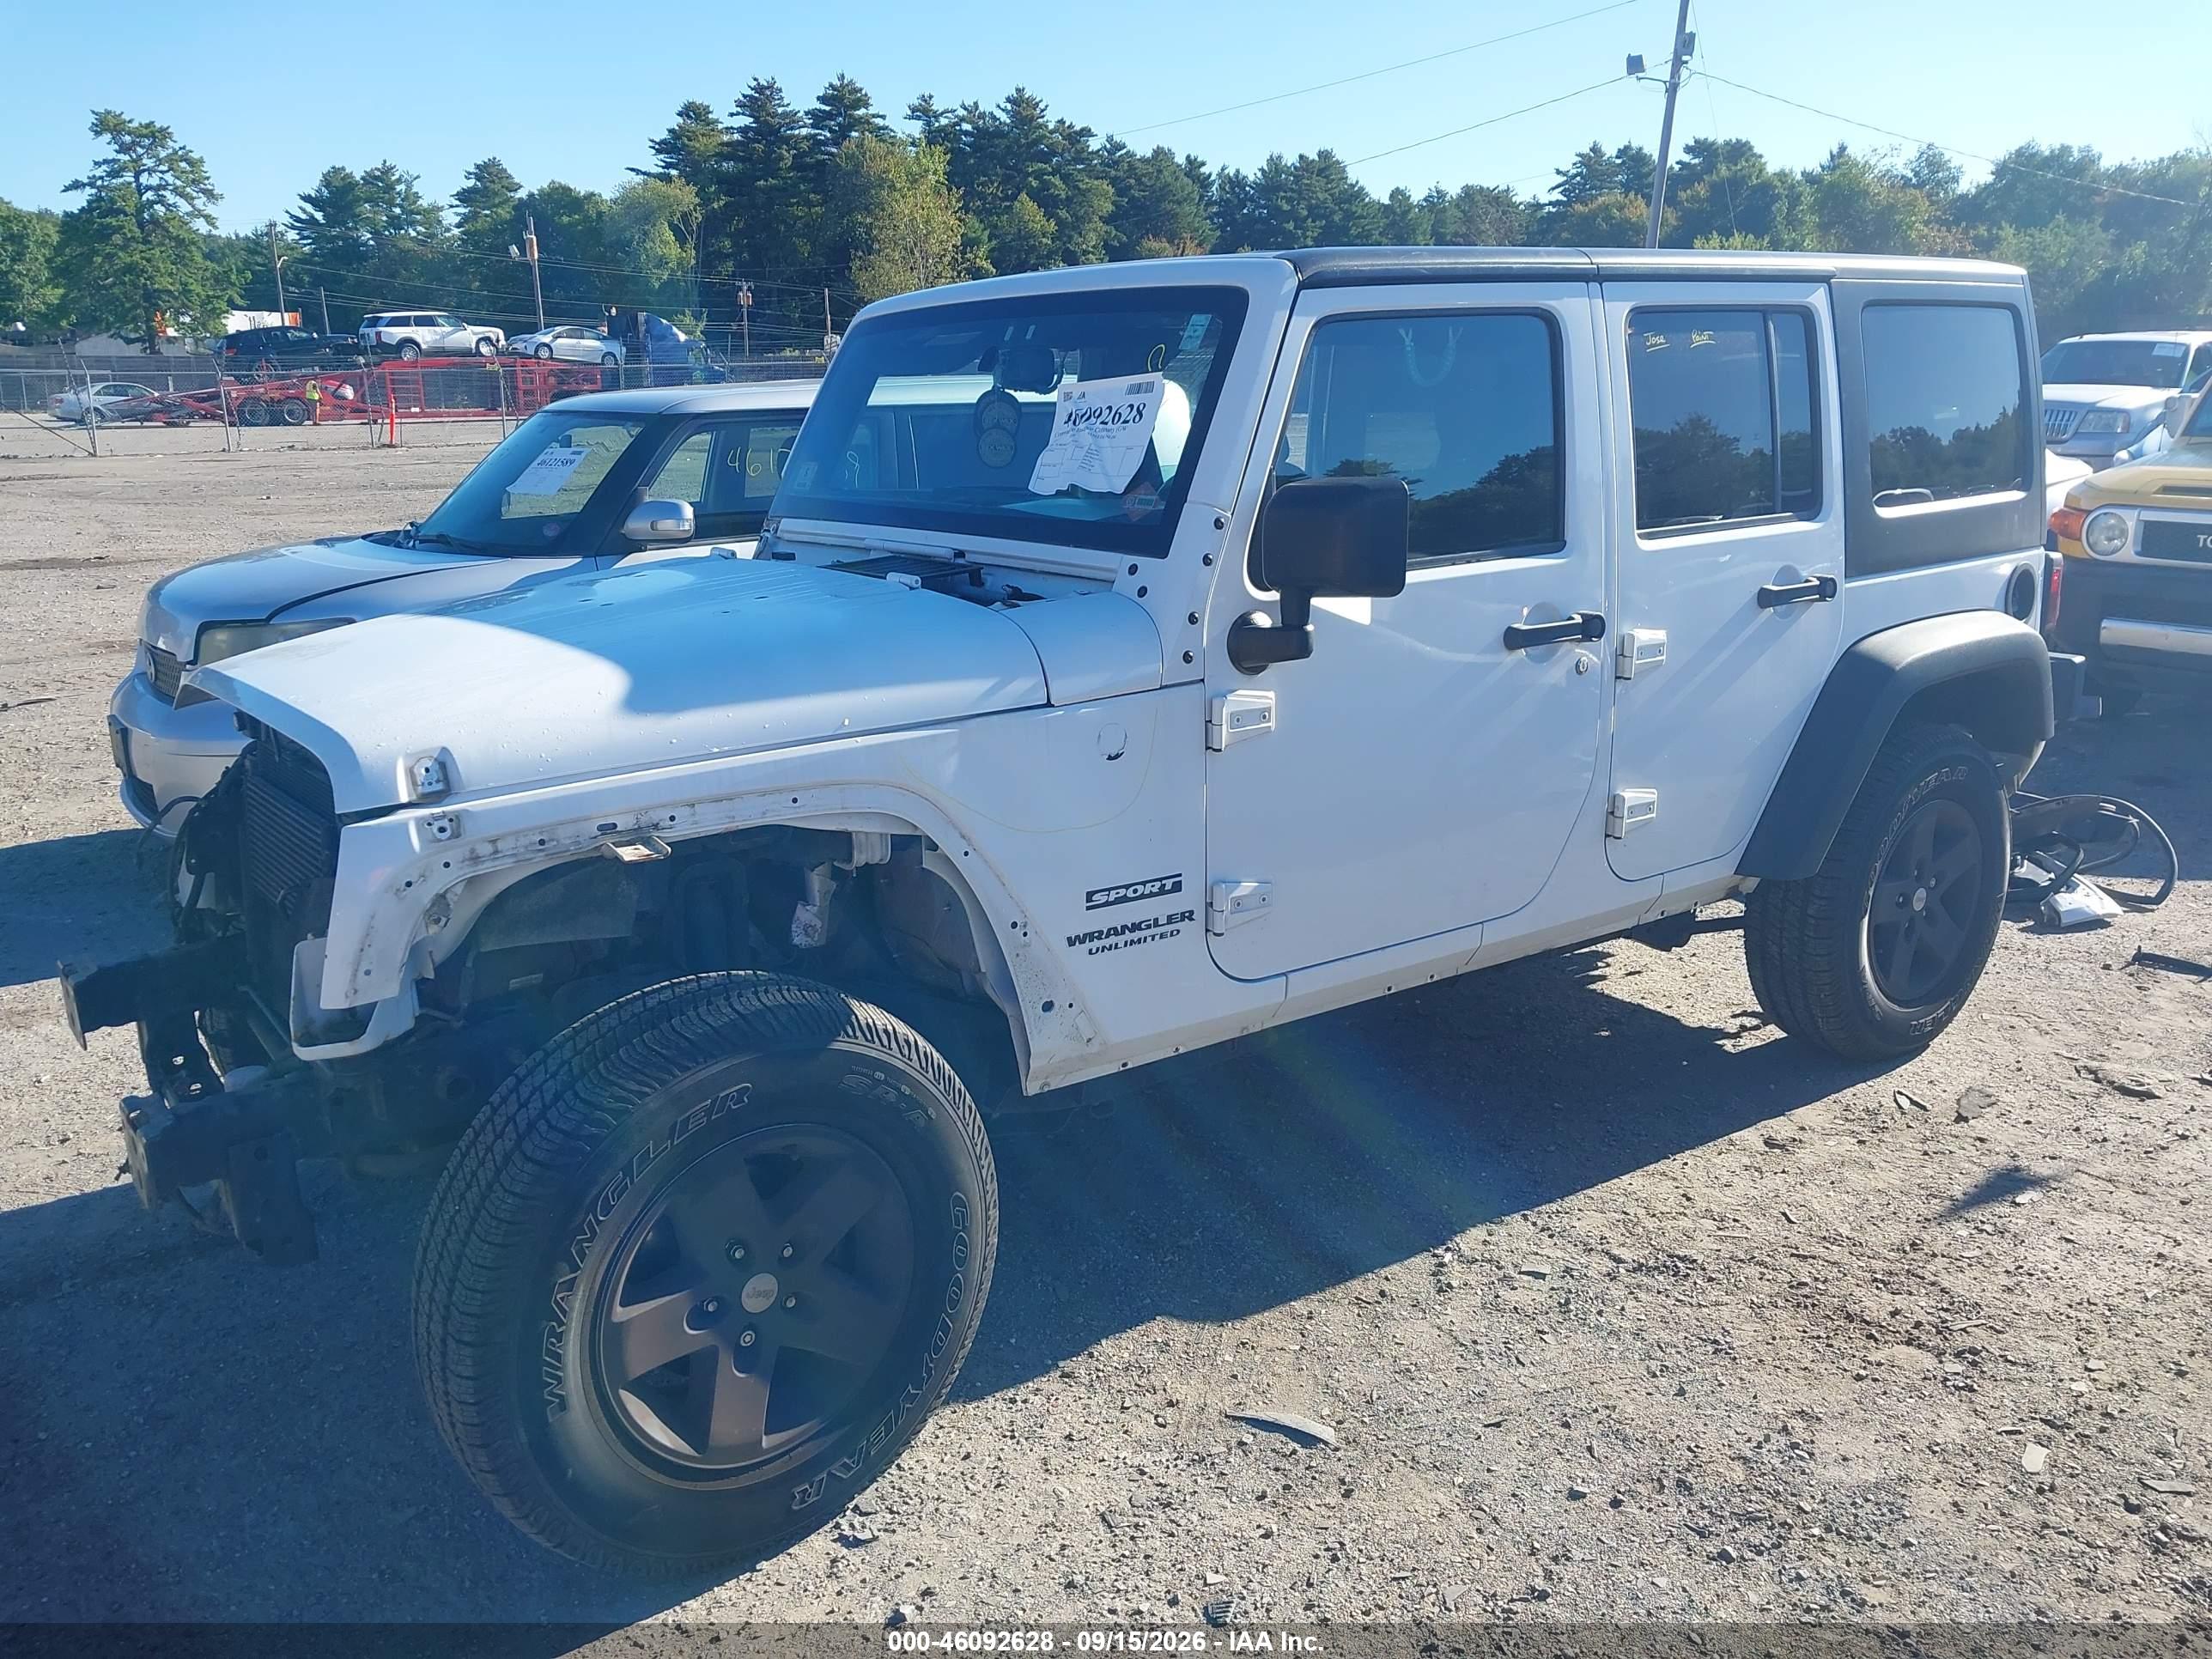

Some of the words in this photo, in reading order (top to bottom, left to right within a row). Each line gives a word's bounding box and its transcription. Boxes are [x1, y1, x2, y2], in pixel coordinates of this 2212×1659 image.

[1643, 331, 1667, 346] Jose
[1091, 878, 1179, 904] SPORT
[1066, 908, 1196, 948] WRANGLER
[1087, 928, 1182, 956] UNLIMITED
[541, 1082, 753, 1423] WRANGLER
[791, 1191, 970, 1510] GOODYEAR
